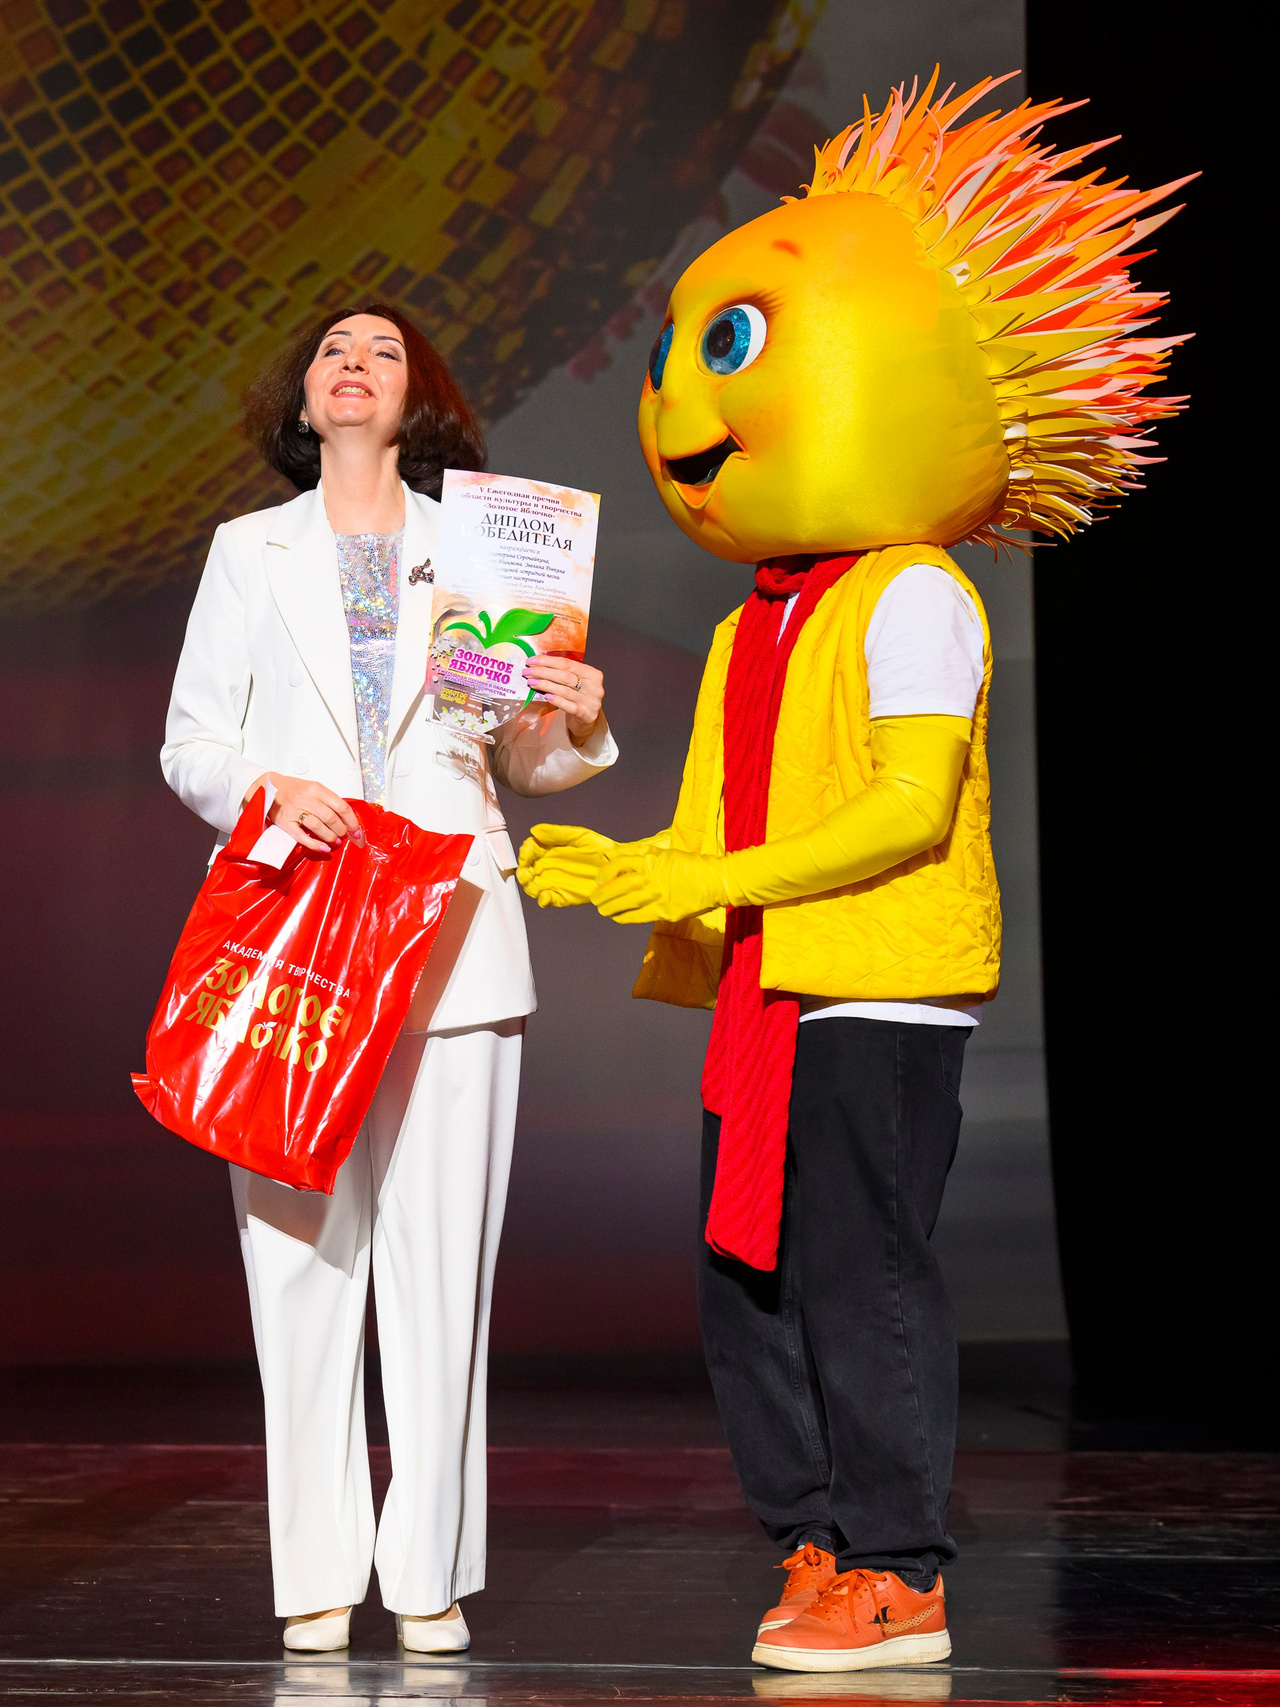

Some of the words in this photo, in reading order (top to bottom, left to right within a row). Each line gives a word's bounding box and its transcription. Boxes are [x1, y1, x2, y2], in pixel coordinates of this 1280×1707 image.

[460, 492, 492, 501] области
[494, 497, 532, 508] культуры
[541, 504, 582, 518] творчества
[487, 487, 530, 499] Ежегодная
[532, 495, 560, 505] премия
[480, 512, 556, 535] ДИПЛОМ
[448, 658, 511, 685] ЯБЛОЧКО
[455, 648, 515, 675] ЗОЛОТОЕ
[493, 684, 517, 695] ОБЛАСТИ
[222, 939, 285, 970] АКАДЕМИЯ
[288, 963, 351, 998] ТВРЧЕСТВА
